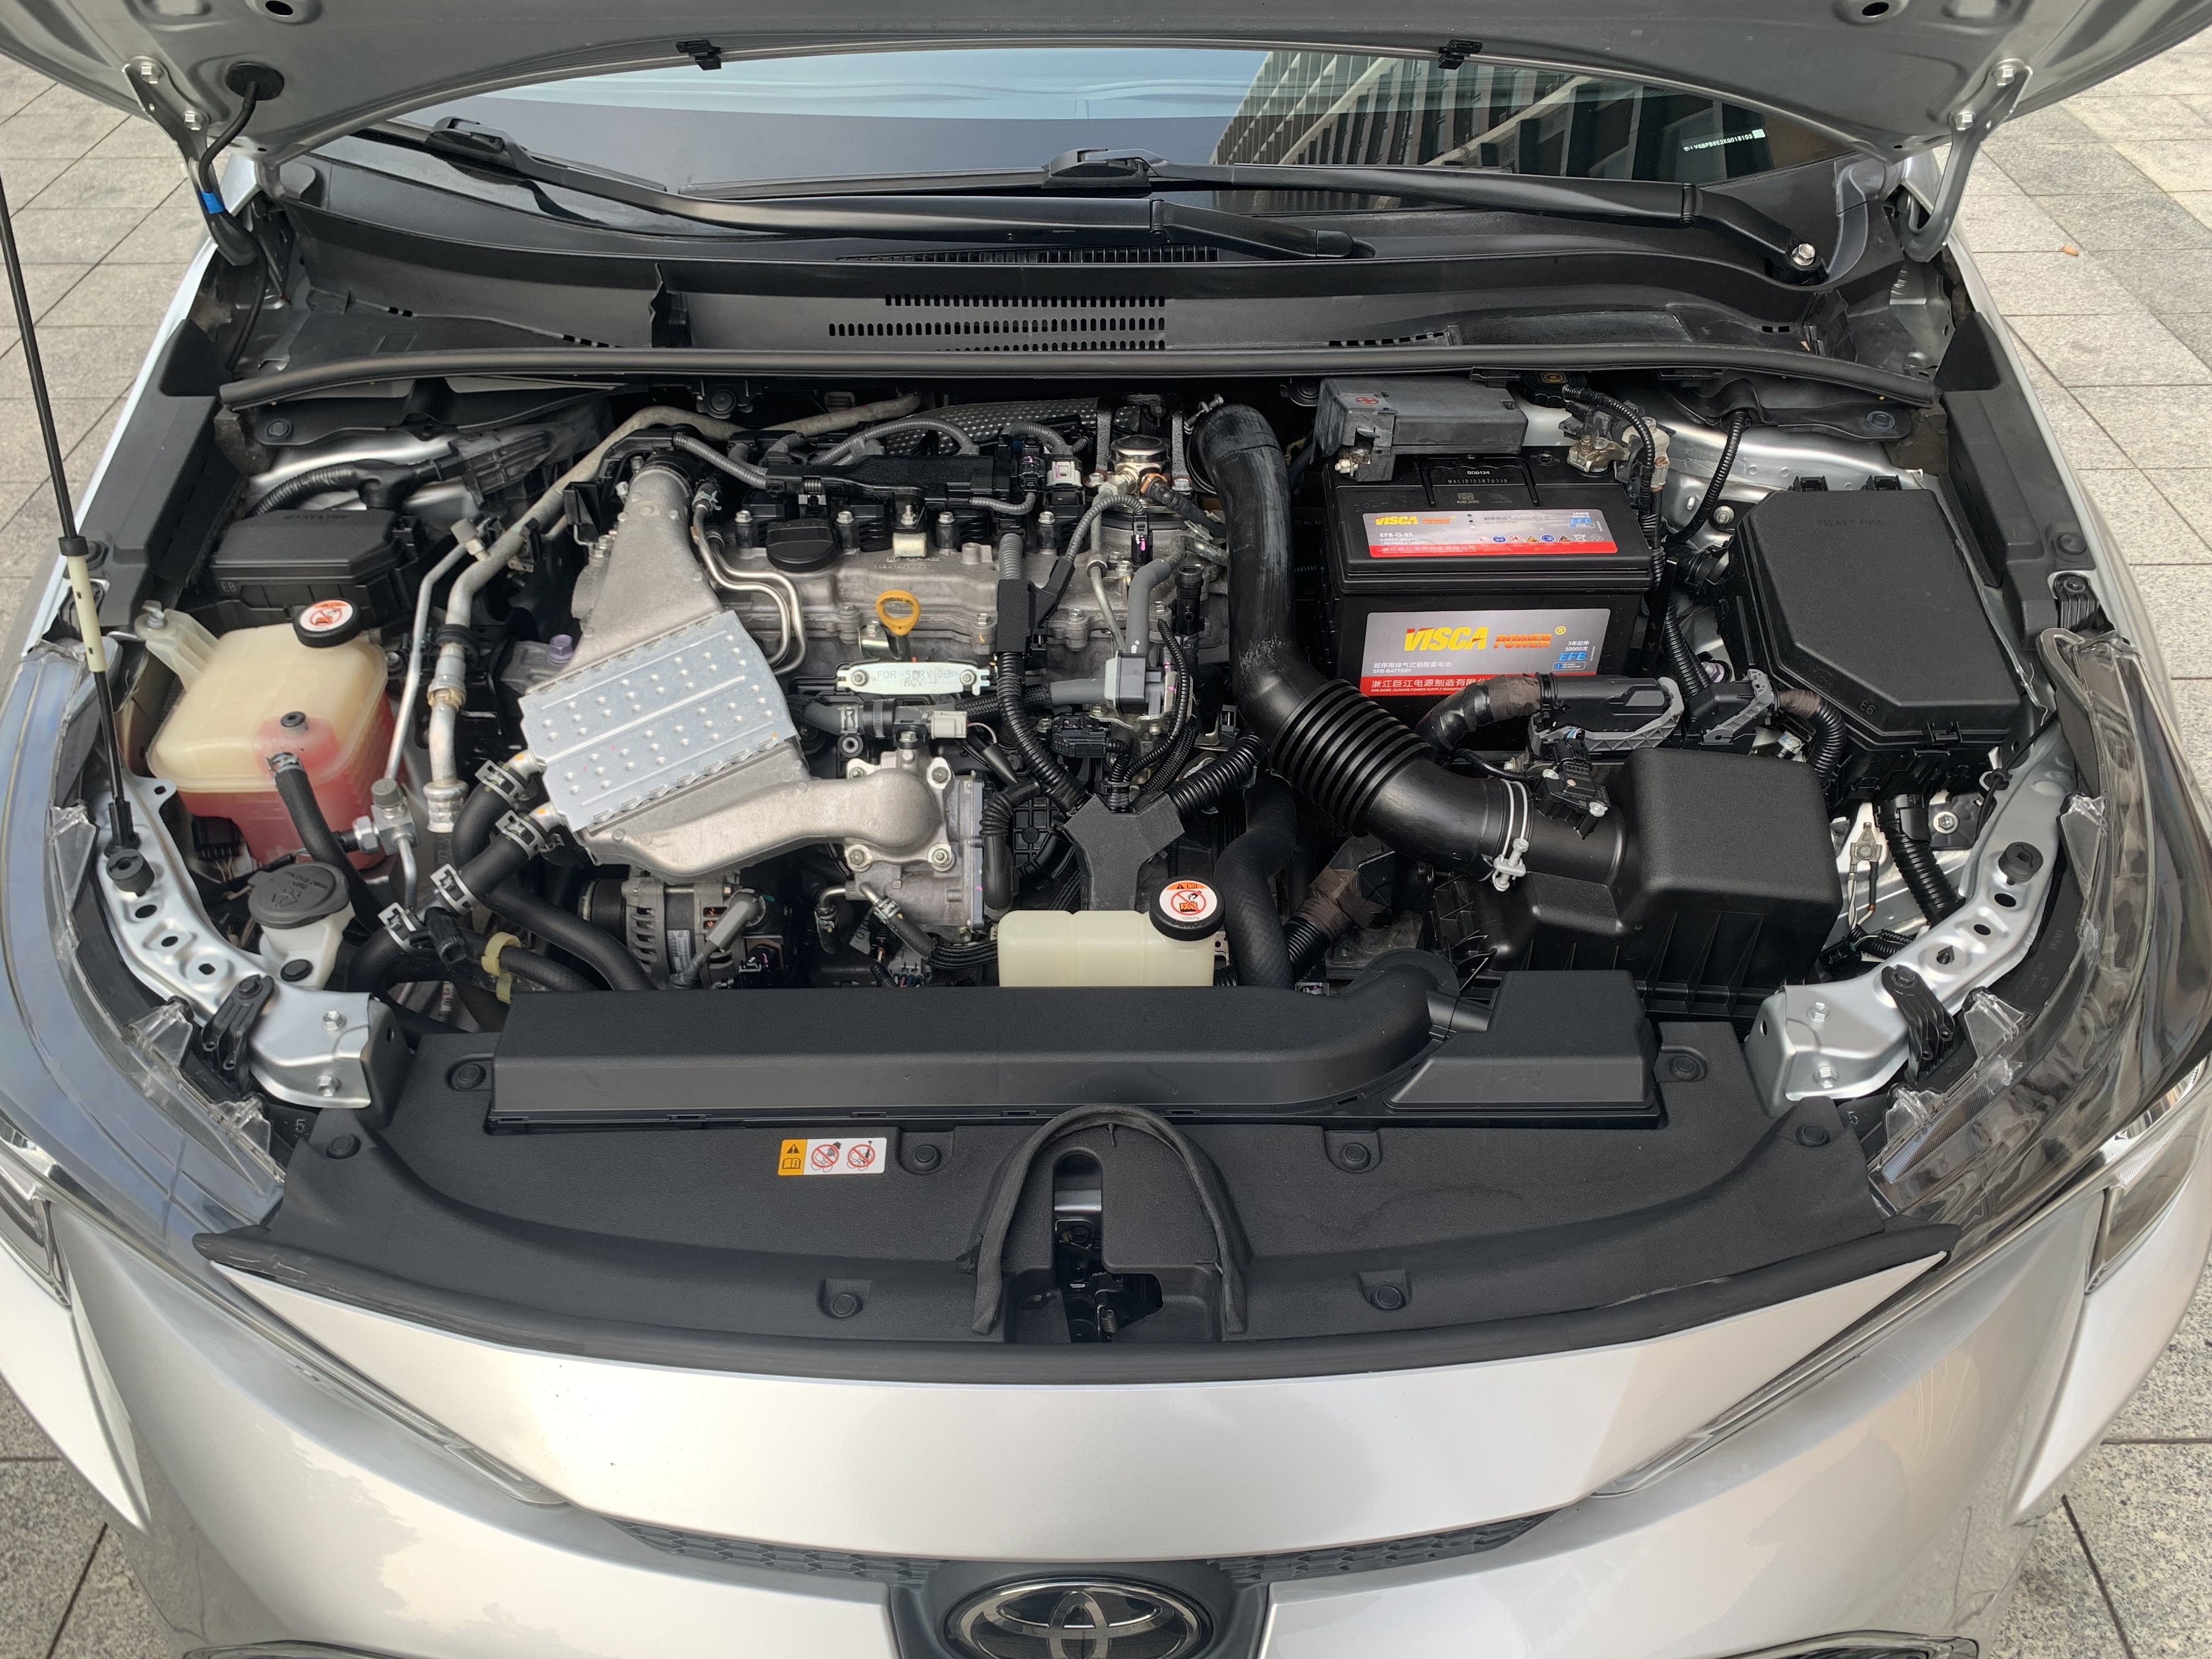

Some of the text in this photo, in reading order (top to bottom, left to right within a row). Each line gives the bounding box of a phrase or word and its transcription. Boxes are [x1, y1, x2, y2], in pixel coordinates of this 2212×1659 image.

[1375, 516, 1419, 526] VISCA
[1404, 626, 1488, 651] VISCA
[1493, 633, 1553, 649] POWER
[1558, 651, 1587, 662] EFB
[878, 670, 951, 679] FOR SERVICE
[904, 678, 924, 687] PCV
[1372, 678, 1491, 688] 浙江巨江电源制造有限
